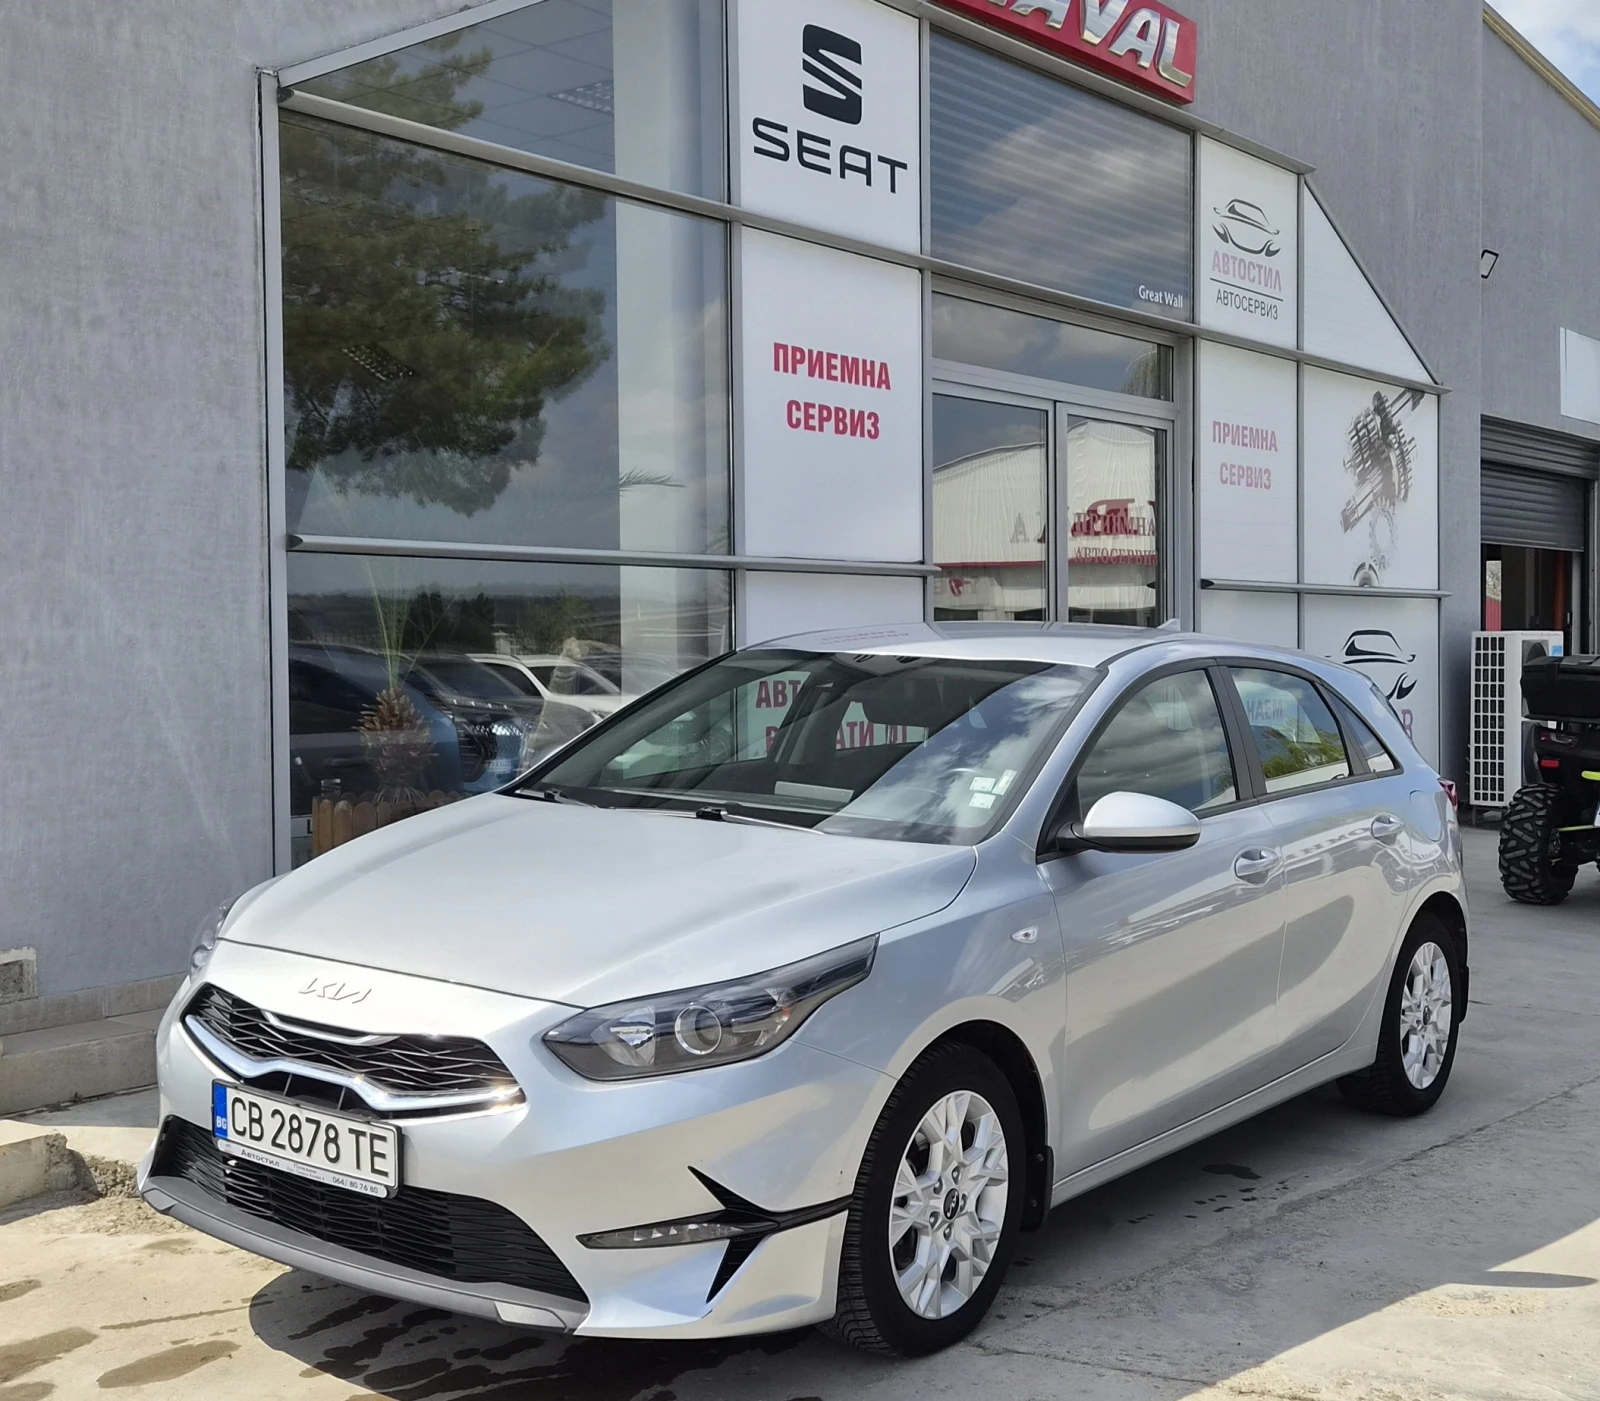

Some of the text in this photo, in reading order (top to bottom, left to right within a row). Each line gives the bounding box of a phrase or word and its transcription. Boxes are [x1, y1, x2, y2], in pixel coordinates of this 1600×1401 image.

[752, 117, 908, 193] SEAT
[1211, 250, 1282, 292] АВТОСТИЛ
[1138, 285, 1183, 309] Great Wall
[1216, 289, 1278, 320] АВТОСЕРВИЗ
[773, 342, 891, 390] ПРИЕМНА
[787, 400, 880, 440] СЕРВИЗ
[1212, 420, 1278, 452] ПРИЕМНА
[1219, 462, 1272, 490] СЕРВИЗ
[216, 1116, 227, 1130] BG
[231, 1097, 389, 1178] CB 2878 TE
[241, 1149, 280, 1168] Автостил
[349, 1181, 358, 1189] 80
[360, 1184, 368, 1192] 76
[370, 1187, 379, 1195] 80
